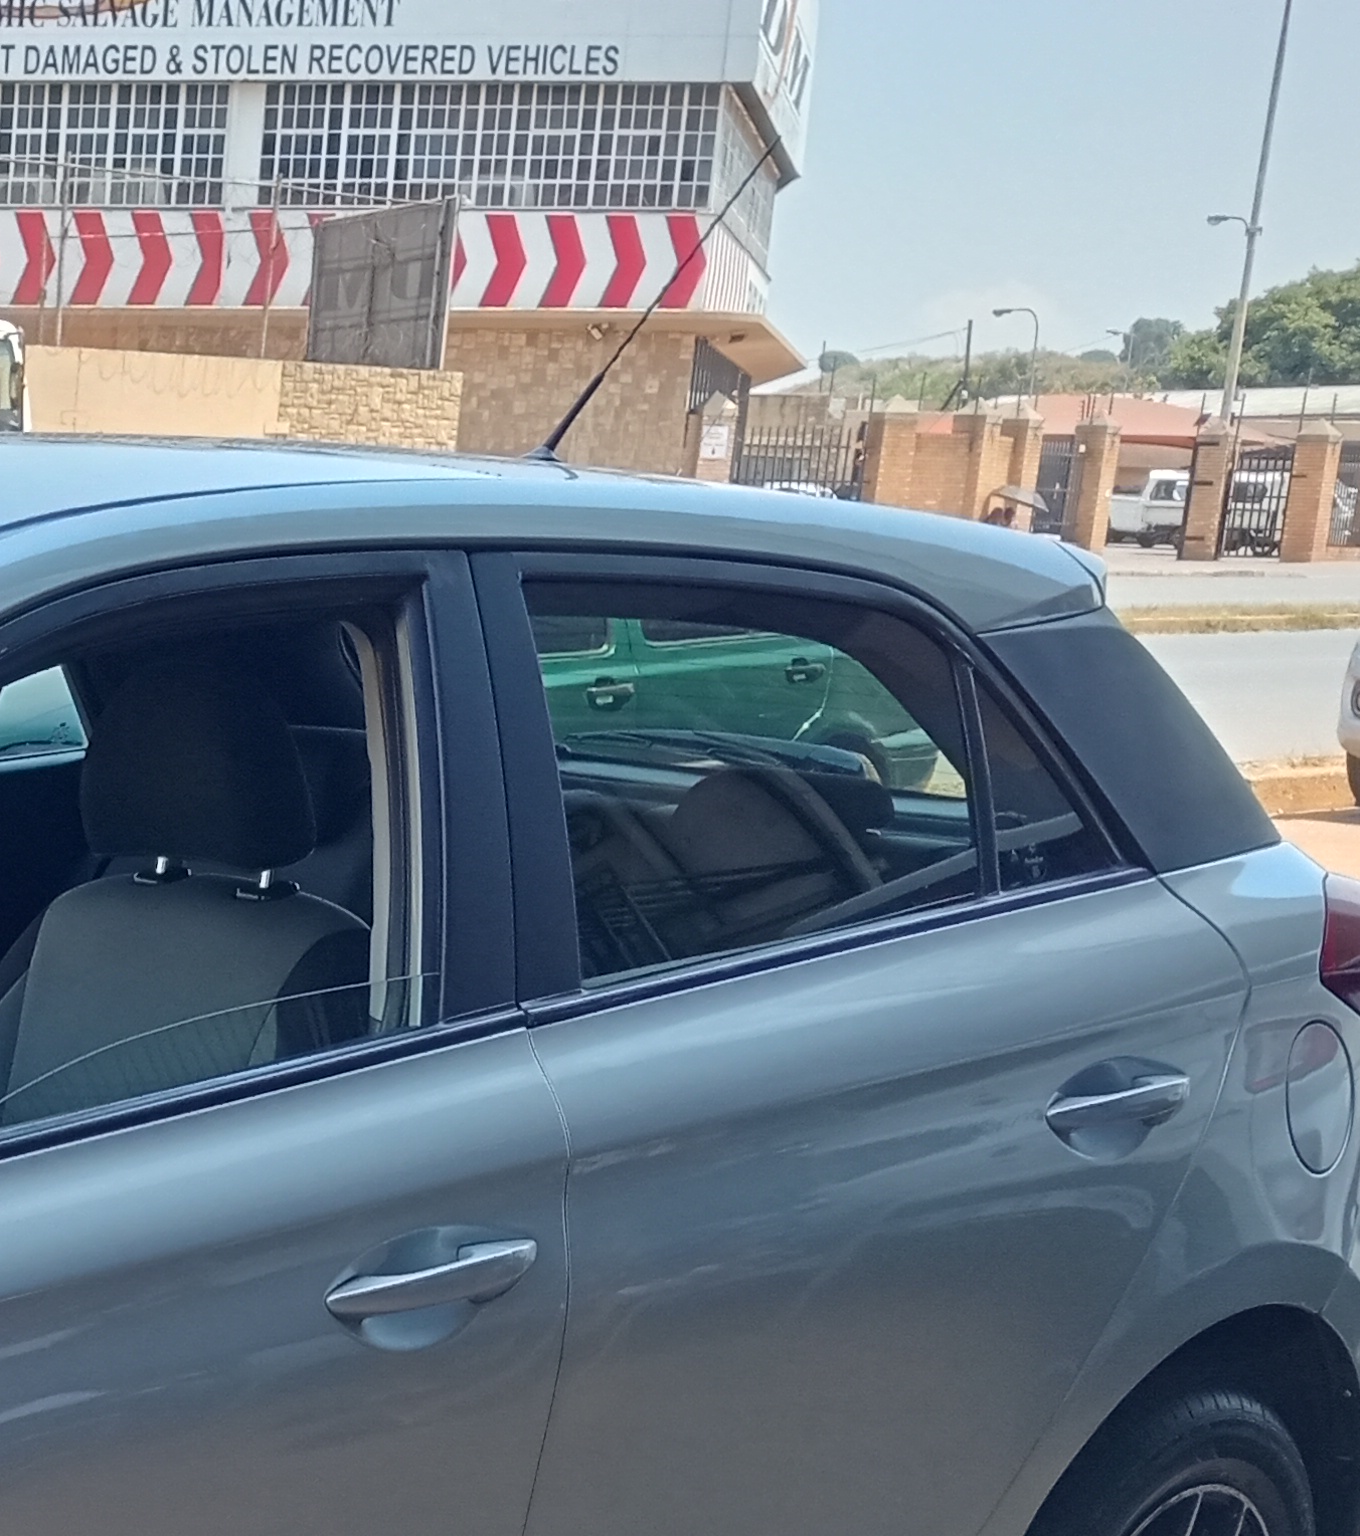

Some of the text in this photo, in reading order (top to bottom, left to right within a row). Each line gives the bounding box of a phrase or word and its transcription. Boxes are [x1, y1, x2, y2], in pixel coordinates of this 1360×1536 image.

[57, 0, 178, 28] SALVAGE
[191, 0, 400, 28] MANAGEMENT
[23, 45, 157, 75] DAMAGED
[165, 45, 183, 75] &
[191, 44, 298, 75] STOLEN
[307, 44, 476, 75] RECOVERED
[486, 45, 620, 76] VEHICLES
